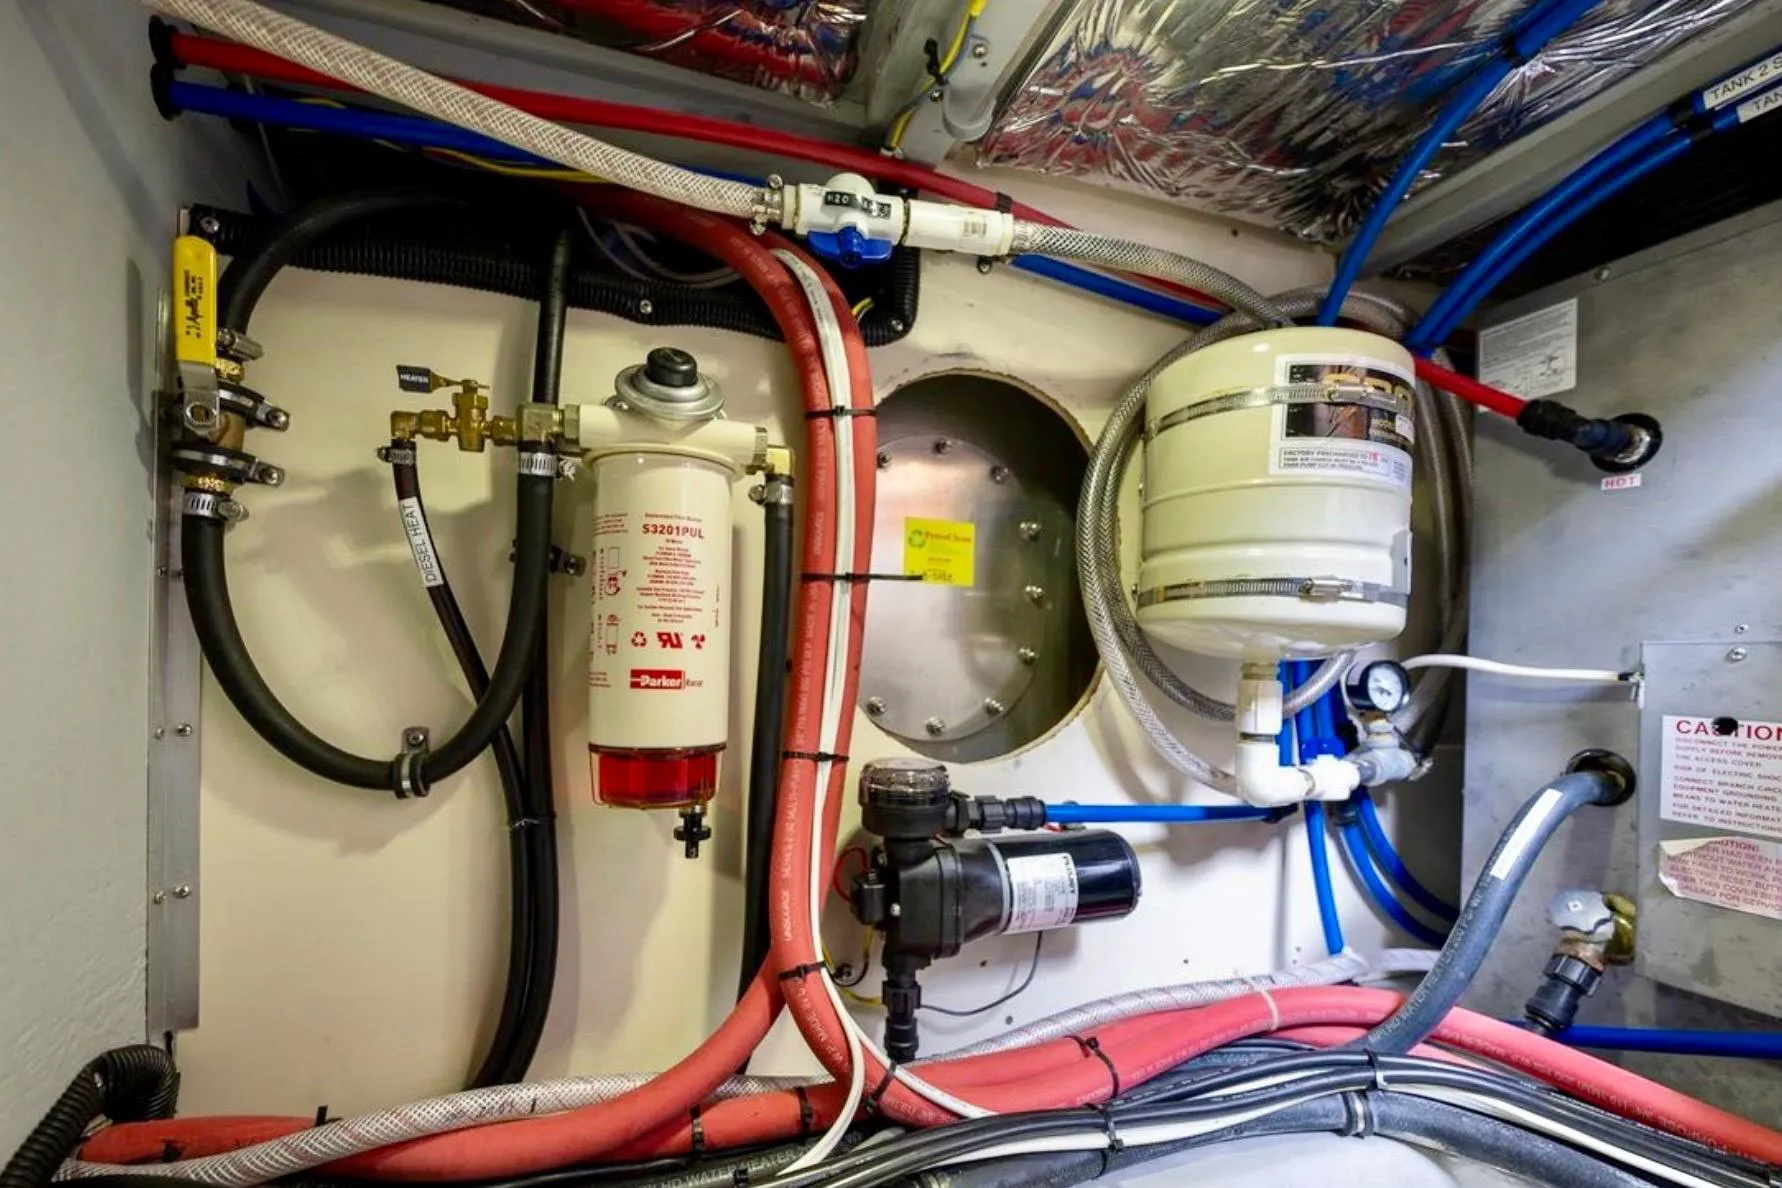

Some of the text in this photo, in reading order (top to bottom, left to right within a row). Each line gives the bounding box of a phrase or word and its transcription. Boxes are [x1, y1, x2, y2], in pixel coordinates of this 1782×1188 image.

[1710, 71, 1755, 100] TANK
[1759, 64, 1769, 77] 2
[642, 523, 704, 538] S3201PUL
[402, 503, 438, 583] DIESEL HEAT
[640, 674, 682, 688] Parker
[1676, 720, 1782, 742] CATIO
